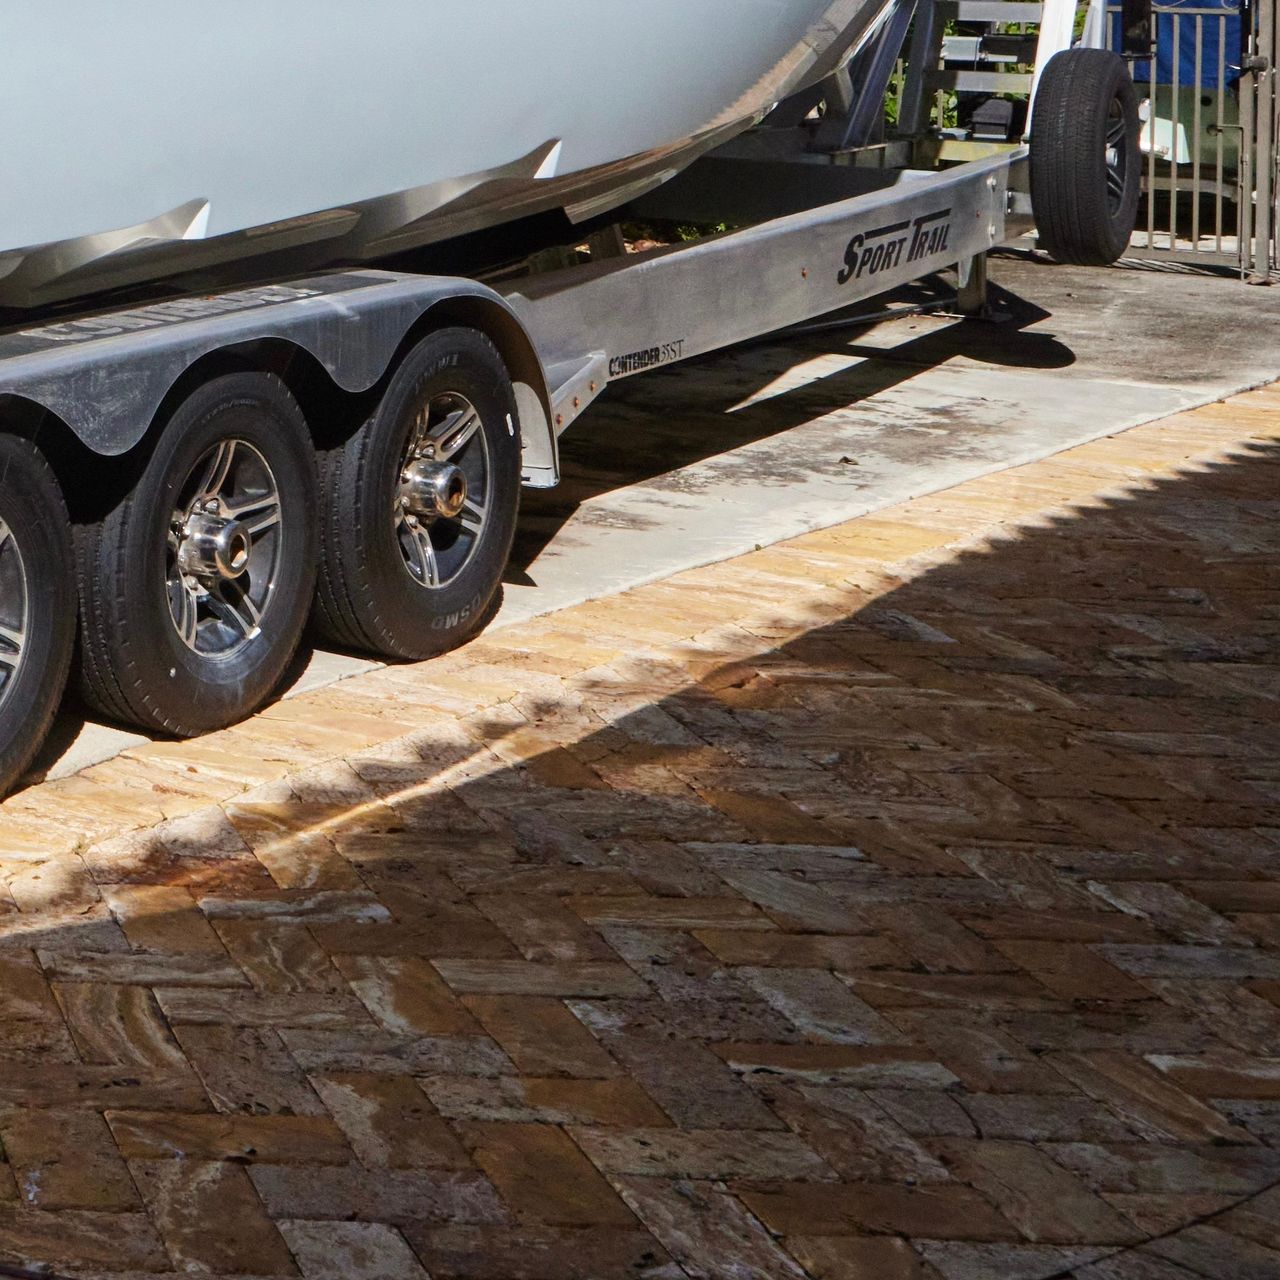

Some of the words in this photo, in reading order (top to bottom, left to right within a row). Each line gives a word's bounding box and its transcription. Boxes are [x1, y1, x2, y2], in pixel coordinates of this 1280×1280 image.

[837, 219, 911, 285] SPORT
[906, 208, 952, 263] TRAIL
[608, 346, 661, 377] CONTENDER
